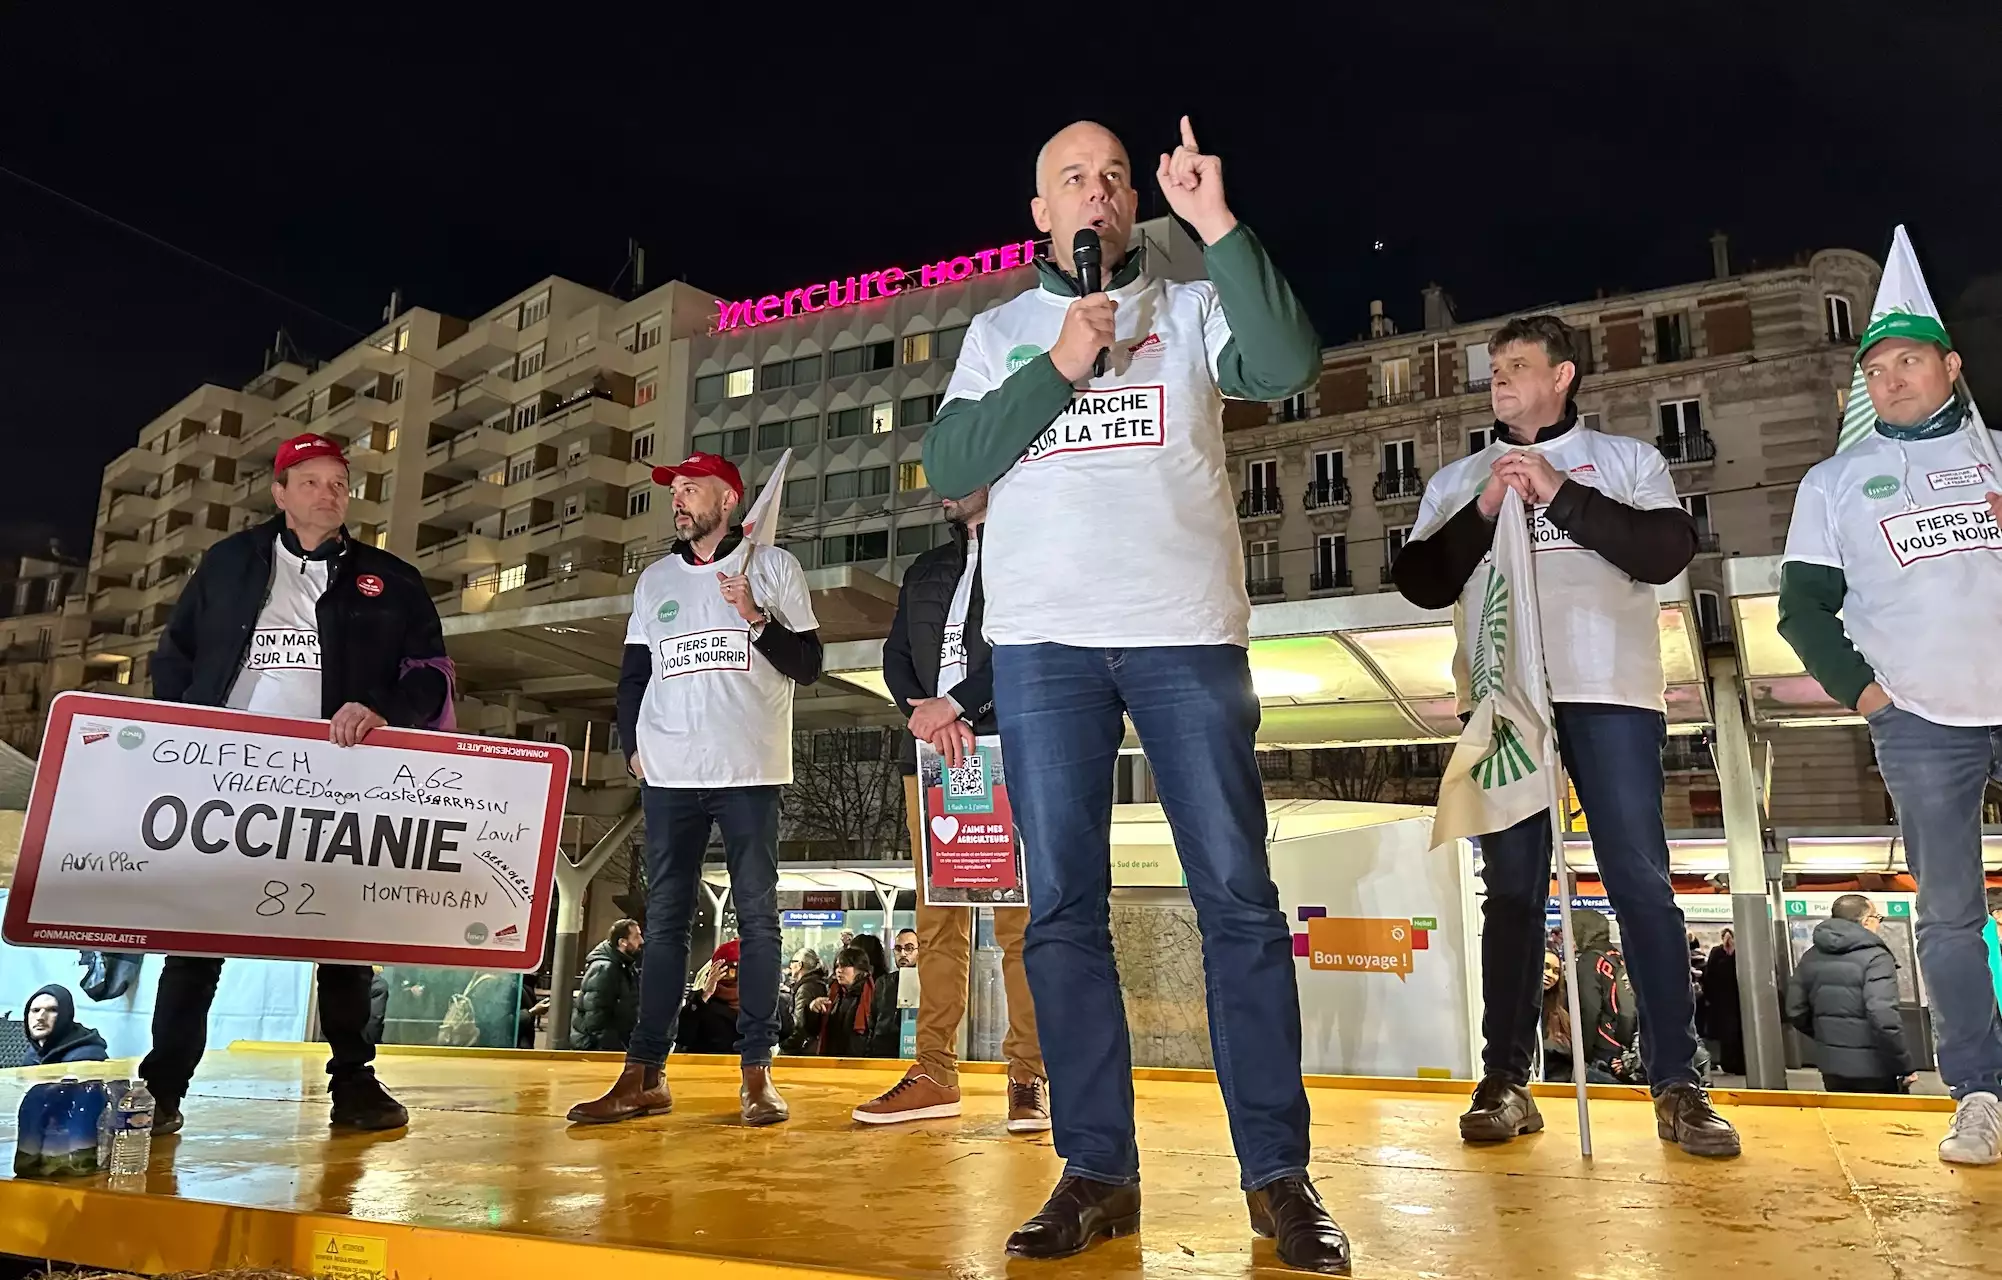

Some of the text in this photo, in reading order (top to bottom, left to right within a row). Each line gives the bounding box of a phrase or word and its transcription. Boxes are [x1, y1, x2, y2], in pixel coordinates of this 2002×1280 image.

[1029, 417, 1154, 456] SUR LA TÊTE
[1916, 510, 1997, 533] FIERS DE
[1897, 533, 1947, 553] VOUS
[255, 634, 276, 646] ON
[677, 636, 728, 654] FIERS DE
[253, 652, 280, 665] SUR
[286, 652, 306, 664] LA
[664, 651, 746, 670] VOUS NOURRIR
[152, 739, 310, 774] GOLFECH
[456, 741, 549, 759] #ONMARCHESURLATETE
[141, 794, 468, 874] OCCITANIE
[961, 824, 1004, 834] J'AIME MES
[957, 834, 1010, 845] AGRICULTEURS
[1117, 860, 1130, 868] Sud
[1131, 860, 1140, 868] de
[1141, 860, 1159, 871] paris
[255, 880, 326, 916] 82
[362, 882, 487, 910] MONTAUBAN
[33, 929, 147, 945] #ONMARCHESURLATETE
[1314, 951, 1343, 965] Bon
[1347, 954, 1398, 970] voyage
